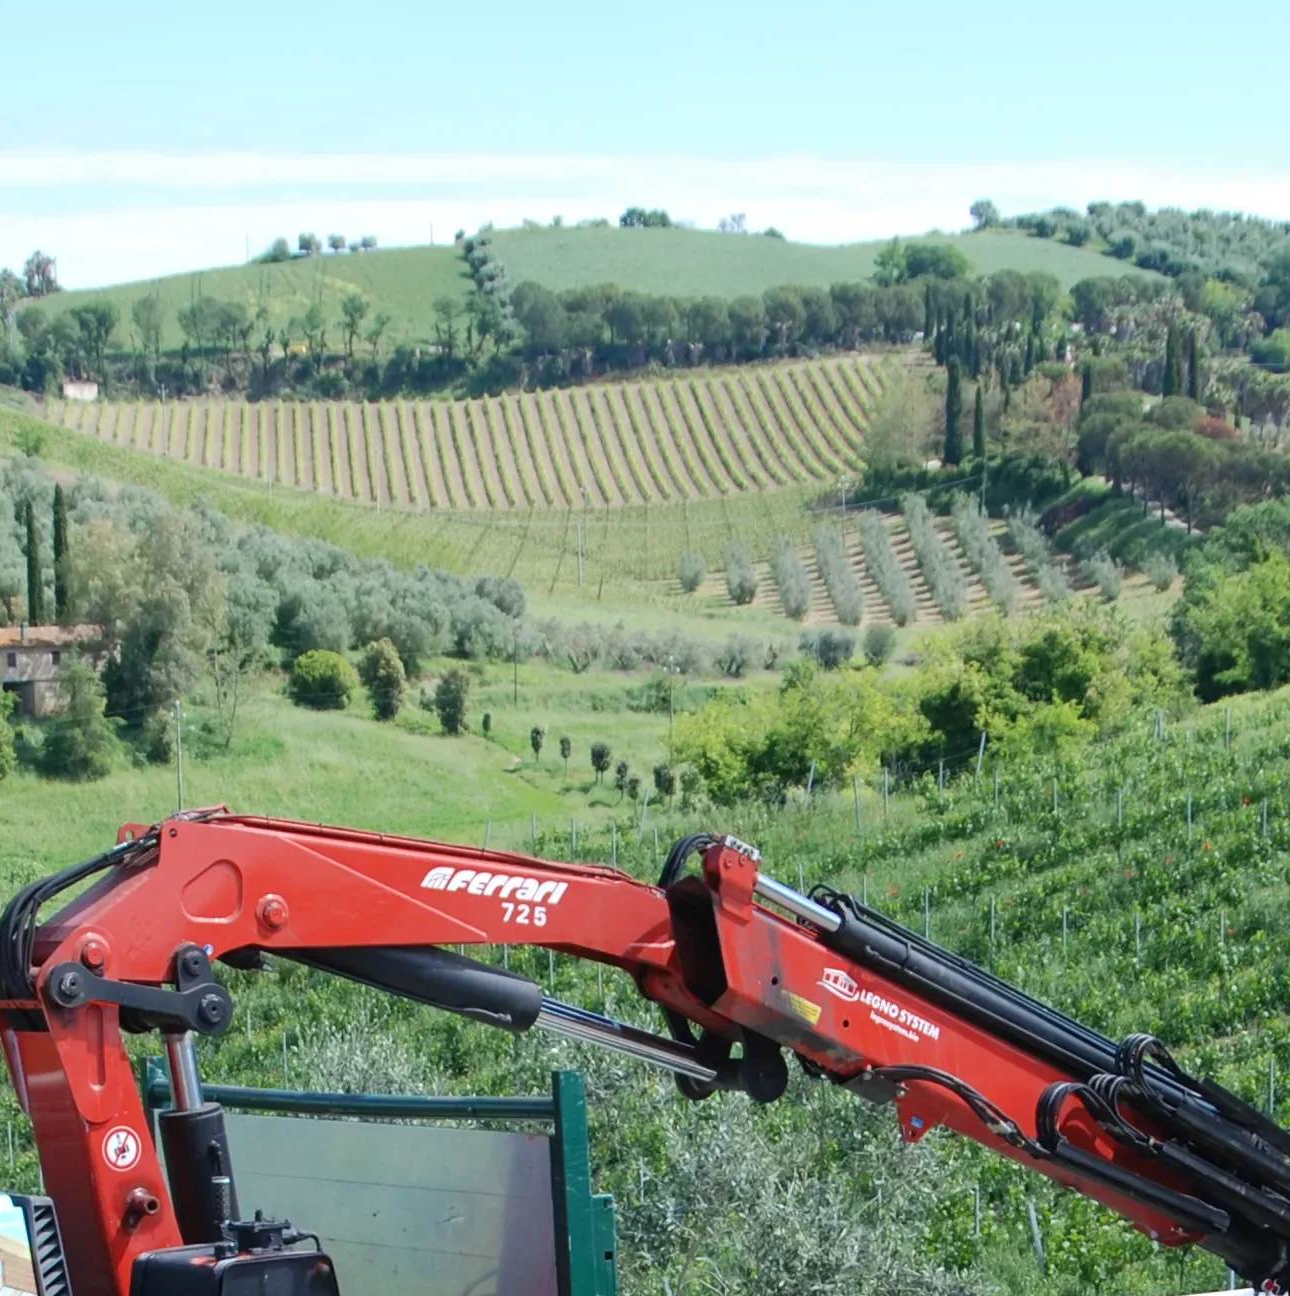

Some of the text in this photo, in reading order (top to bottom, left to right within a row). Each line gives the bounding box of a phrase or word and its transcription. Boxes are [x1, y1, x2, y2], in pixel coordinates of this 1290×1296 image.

[501, 901, 547, 927] 725
[860, 988, 941, 1040] LEGNO SYSTEM
